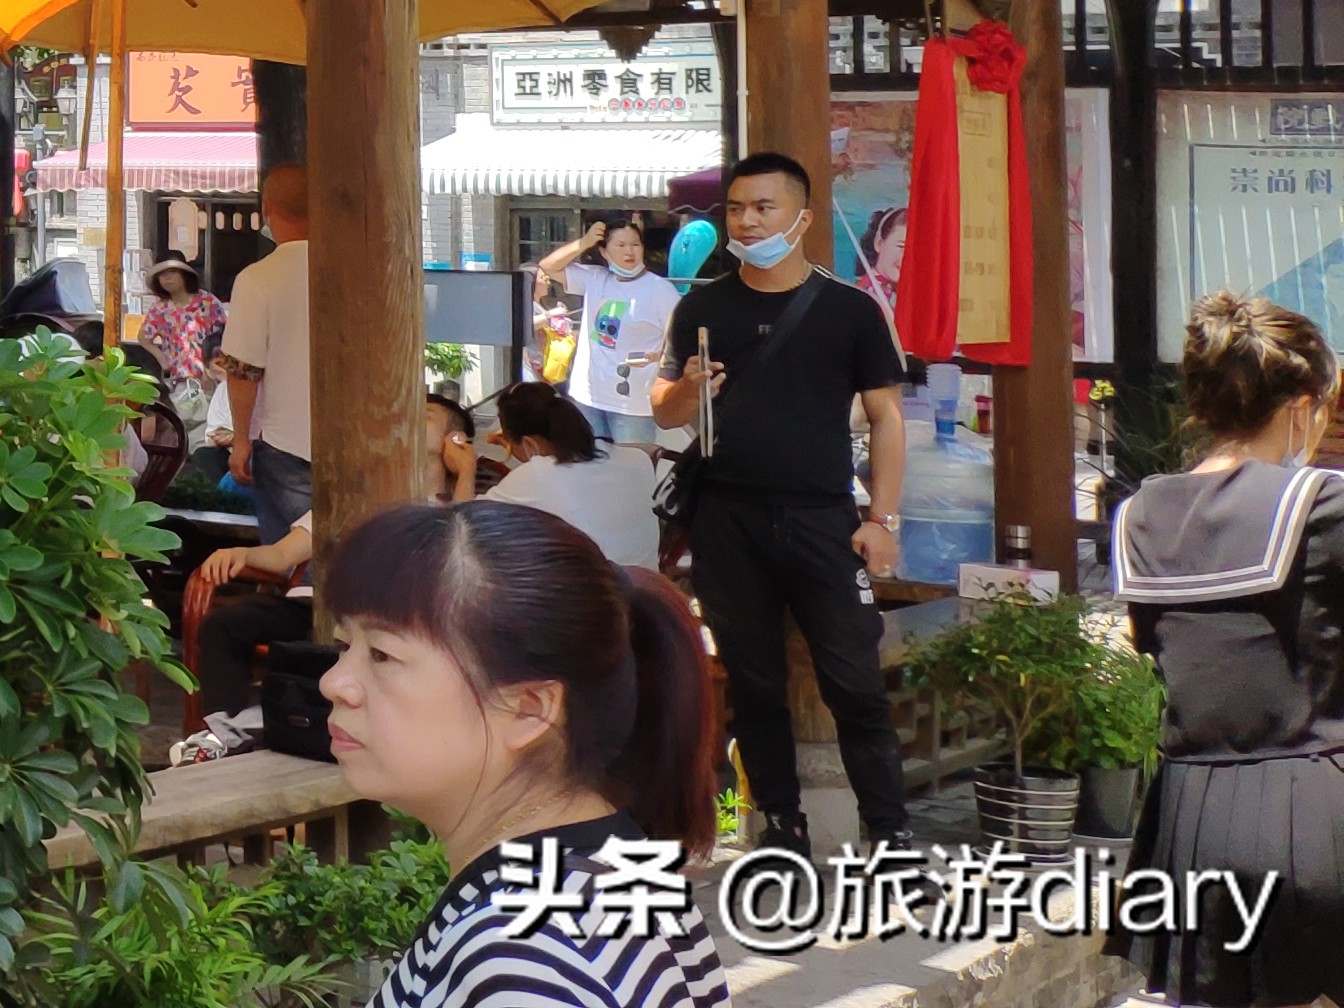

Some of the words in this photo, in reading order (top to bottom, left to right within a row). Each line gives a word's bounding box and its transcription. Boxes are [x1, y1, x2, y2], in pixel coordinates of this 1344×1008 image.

[514, 66, 713, 97] 亞洲零食有限
